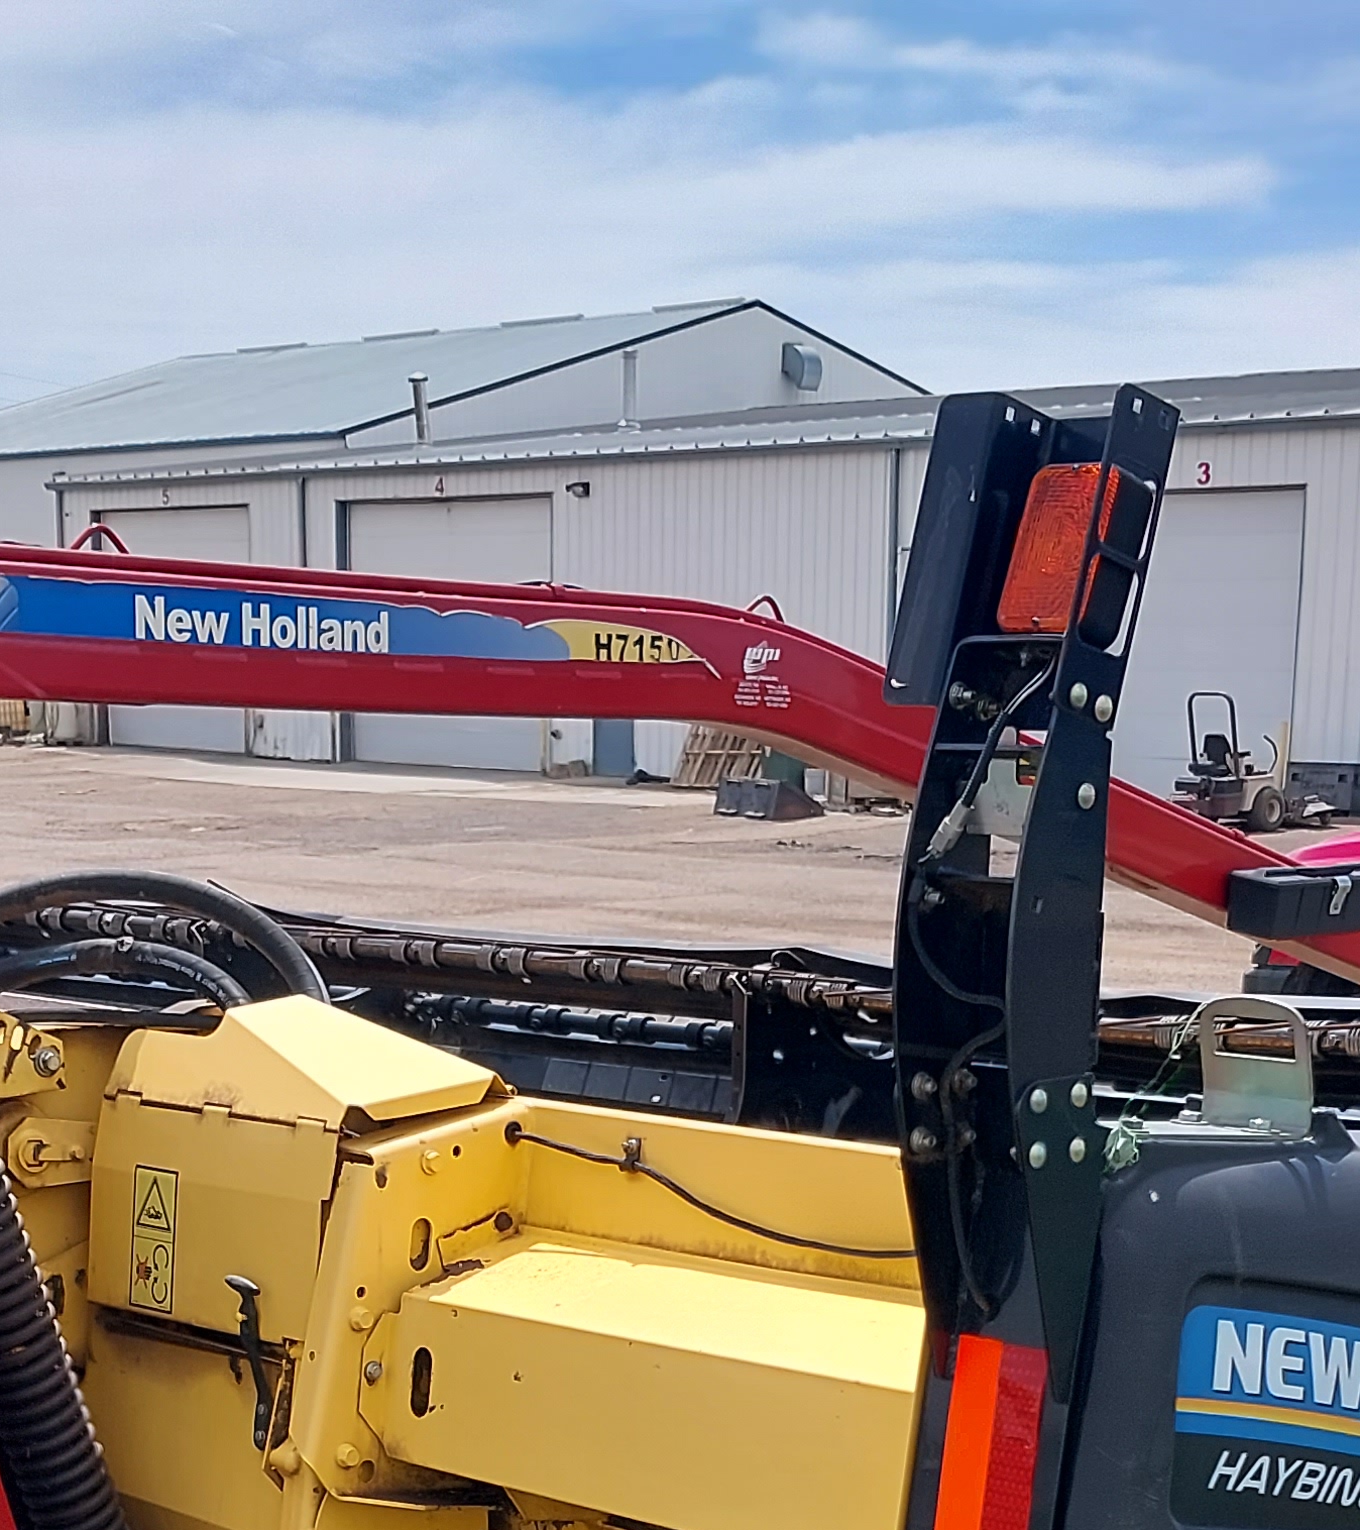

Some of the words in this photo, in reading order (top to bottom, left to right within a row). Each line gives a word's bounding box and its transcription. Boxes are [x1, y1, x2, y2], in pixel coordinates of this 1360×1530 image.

[435, 476, 444, 496] 4
[1196, 461, 1211, 486] 3
[162, 487, 170, 505] 5
[134, 594, 229, 644] New
[241, 602, 389, 653] Holland
[594, 633, 680, 662] H7150
